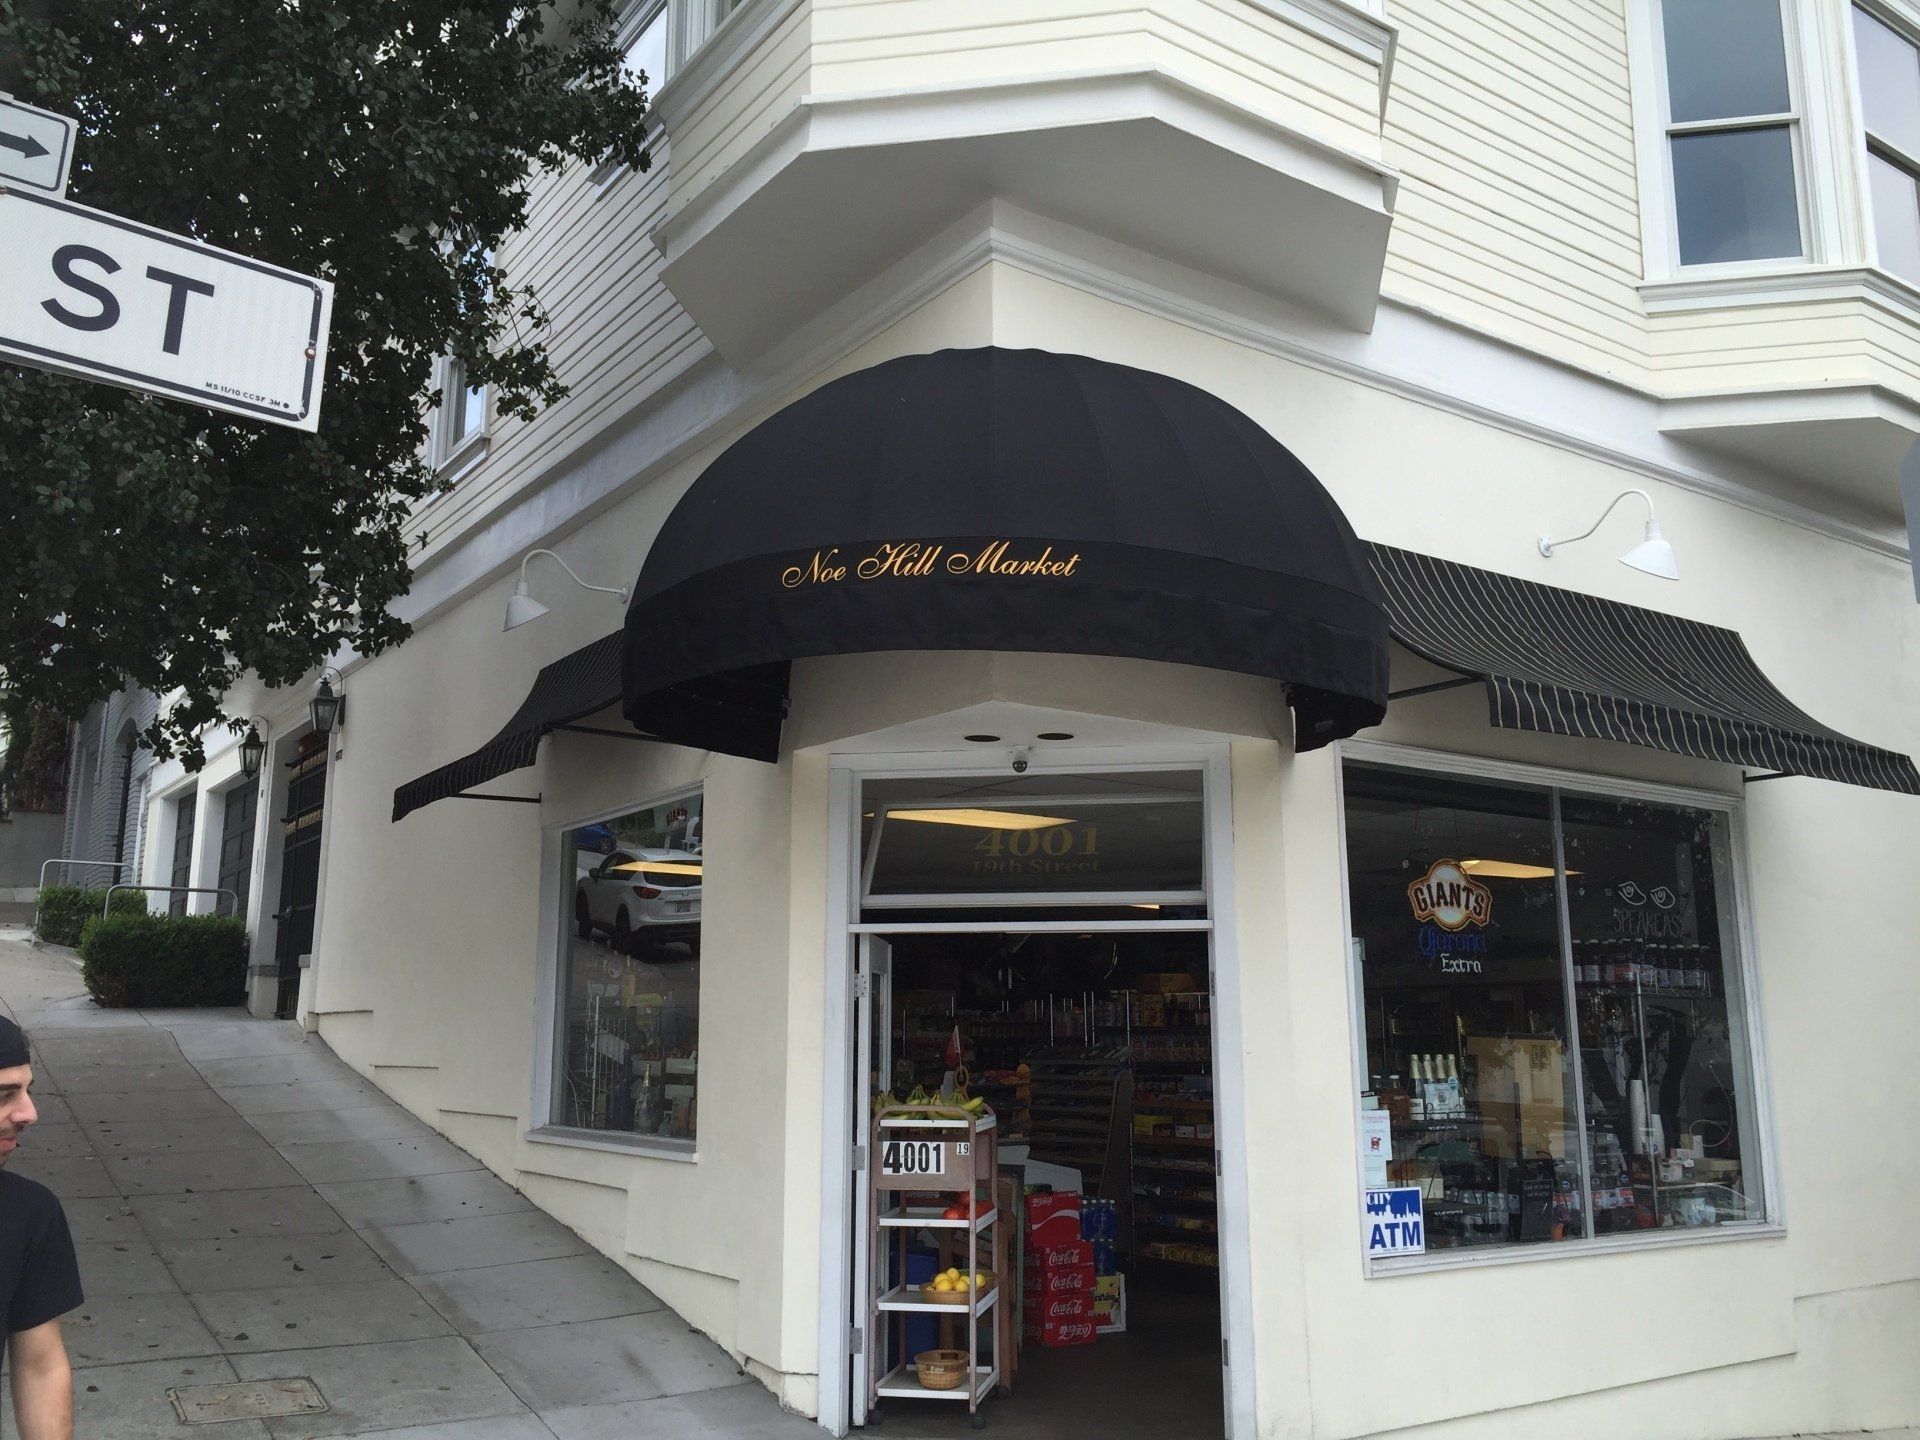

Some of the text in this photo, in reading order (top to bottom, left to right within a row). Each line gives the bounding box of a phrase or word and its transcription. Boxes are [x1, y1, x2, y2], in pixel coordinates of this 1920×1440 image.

[40, 243, 215, 356] ST
[205, 382, 219, 390] MS
[242, 391, 267, 402] CCSF
[782, 541, 1082, 588] Noe Hill Market
[975, 827, 1100, 856] 4001
[1028, 859, 1100, 873] Street
[1413, 881, 1486, 917] GIANTS
[1418, 924, 1488, 958] Corona
[1440, 953, 1482, 973] Extra
[883, 1142, 969, 1174] 4001 19
[1367, 1192, 1392, 1206] CITY
[1370, 1221, 1421, 1249] ATM
